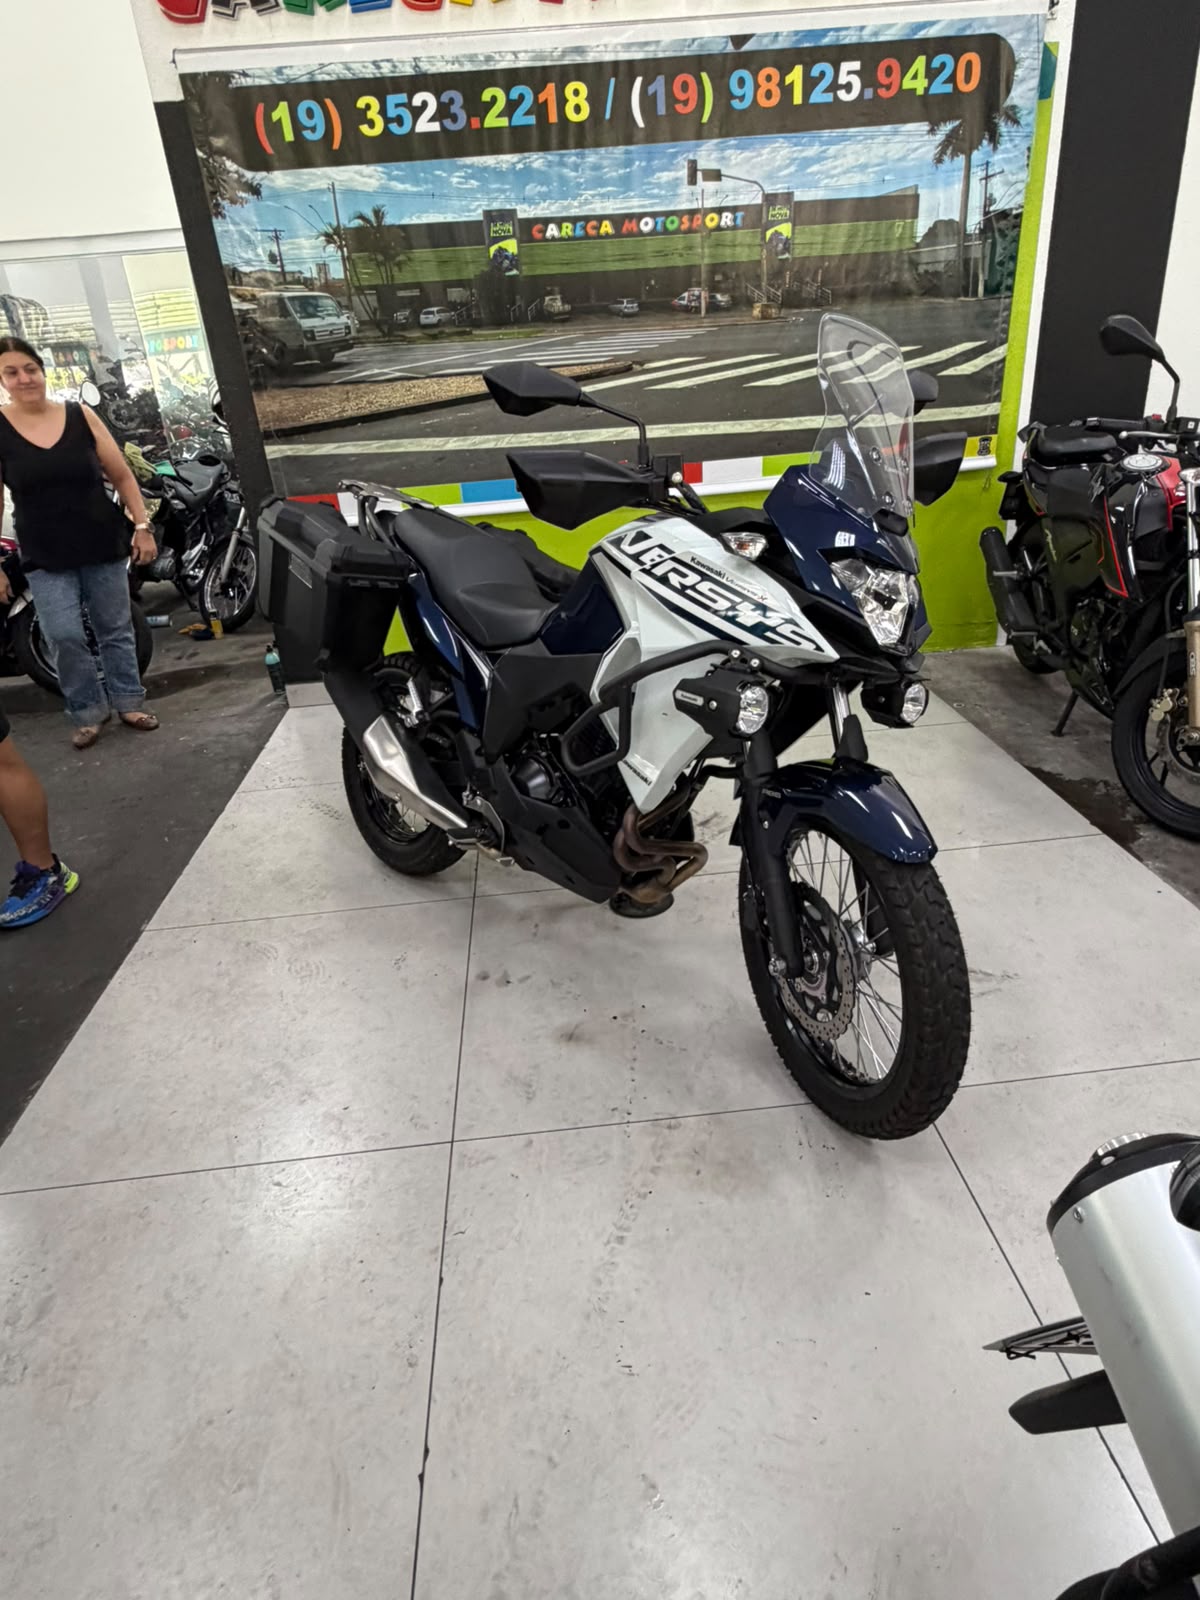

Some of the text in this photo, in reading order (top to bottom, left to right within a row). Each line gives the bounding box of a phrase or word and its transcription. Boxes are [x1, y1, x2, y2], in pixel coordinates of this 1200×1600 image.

[255, 99, 342, 154] (19)
[356, 81, 590, 137] 3523.2218
[631, 72, 713, 128] (19)
[729, 51, 981, 110] 98125.9420
[531, 211, 745, 240] CARECA MOTOSPORT
[689, 555, 726, 580] Kawasaki
